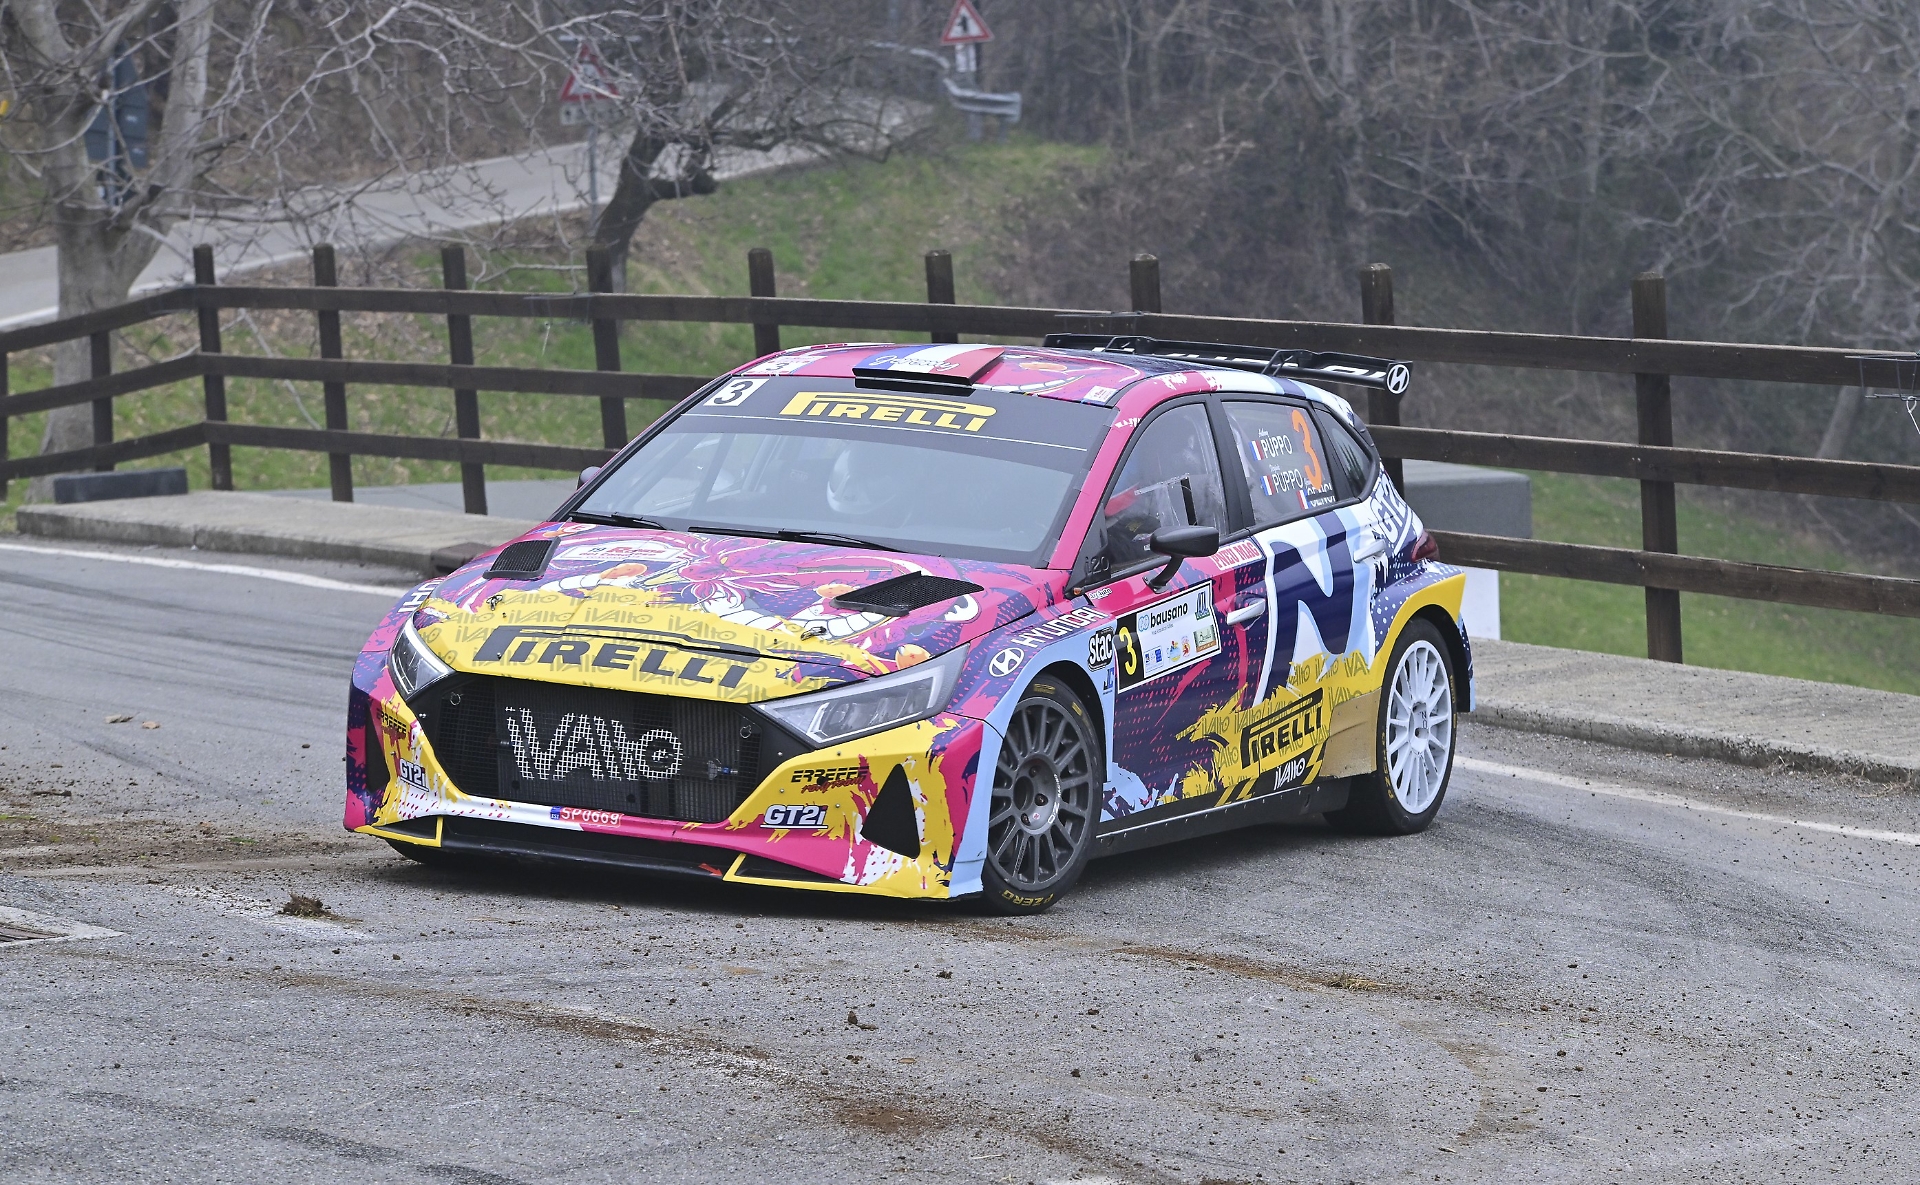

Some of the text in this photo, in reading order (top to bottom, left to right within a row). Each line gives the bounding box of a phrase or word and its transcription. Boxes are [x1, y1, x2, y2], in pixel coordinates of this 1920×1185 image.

[713, 381, 753, 405] 3
[779, 391, 998, 433] PIRELLI
[1260, 435, 1293, 459] PUPPO
[1291, 410, 1322, 490] 3
[1271, 468, 1304, 494] PUPPO
[1212, 541, 1260, 568] PNEU MAC
[1010, 605, 1110, 649] HYUNDAI
[1150, 602, 1188, 629] bausano
[472, 624, 761, 689] PIRELLI
[1089, 633, 1113, 665] stac
[1118, 626, 1138, 676] 3
[1240, 687, 1324, 769] PIRELLI
[399, 759, 427, 788] GT2i
[790, 765, 870, 783] ERREFFE
[561, 806, 619, 825] SP0669
[763, 804, 826, 826] GT2i
[1001, 889, 1044, 907] ZERO
